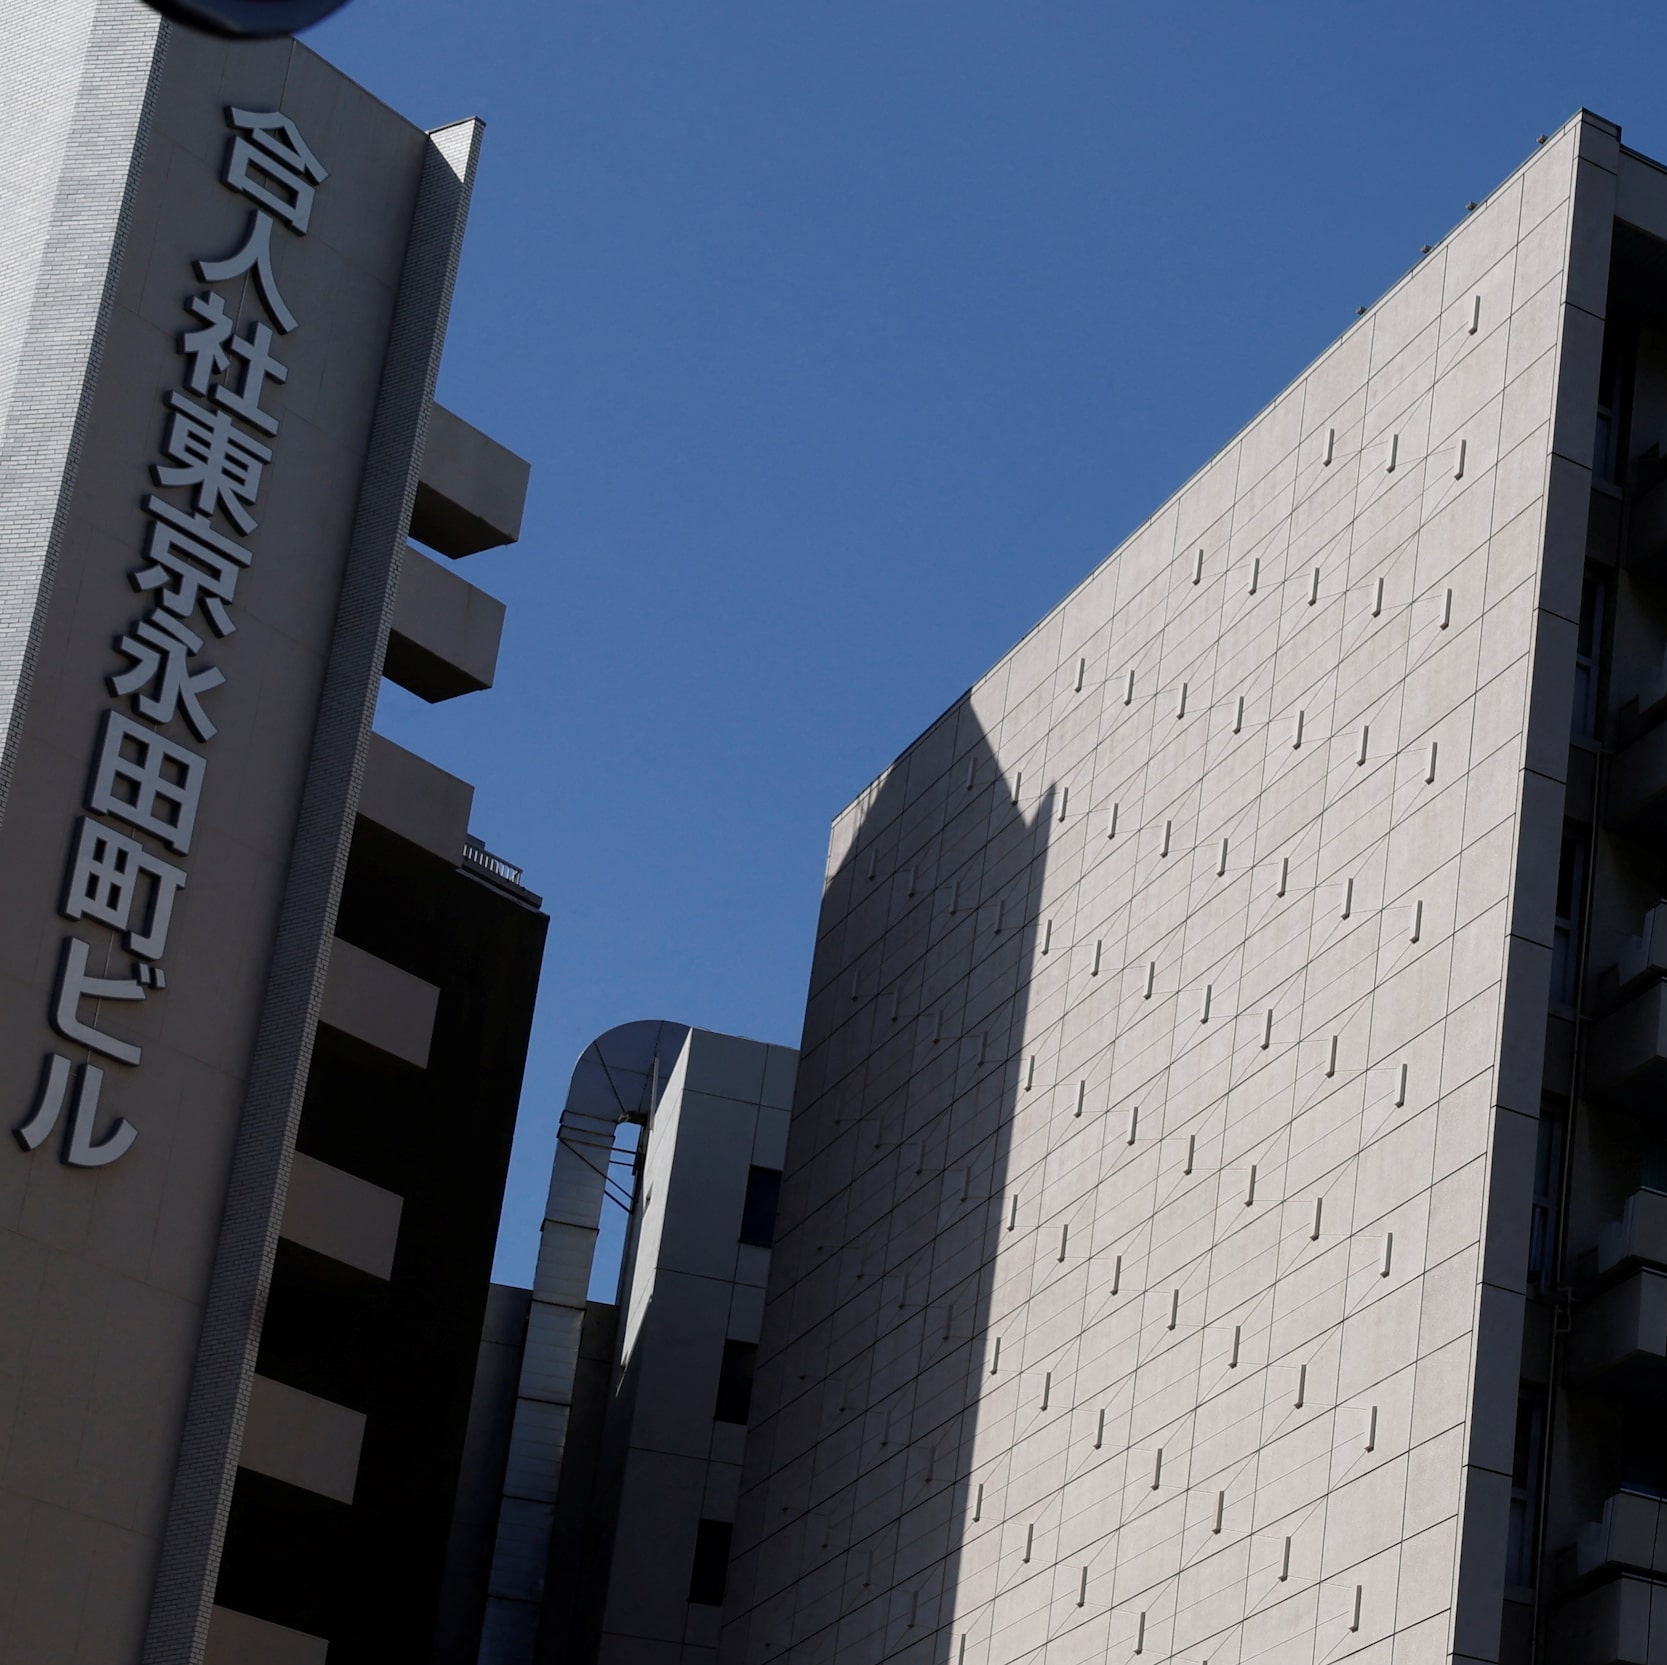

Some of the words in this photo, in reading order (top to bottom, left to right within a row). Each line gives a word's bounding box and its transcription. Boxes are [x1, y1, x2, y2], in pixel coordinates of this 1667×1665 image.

[14, 104, 330, 1168] 合人社東京永田町ビル
